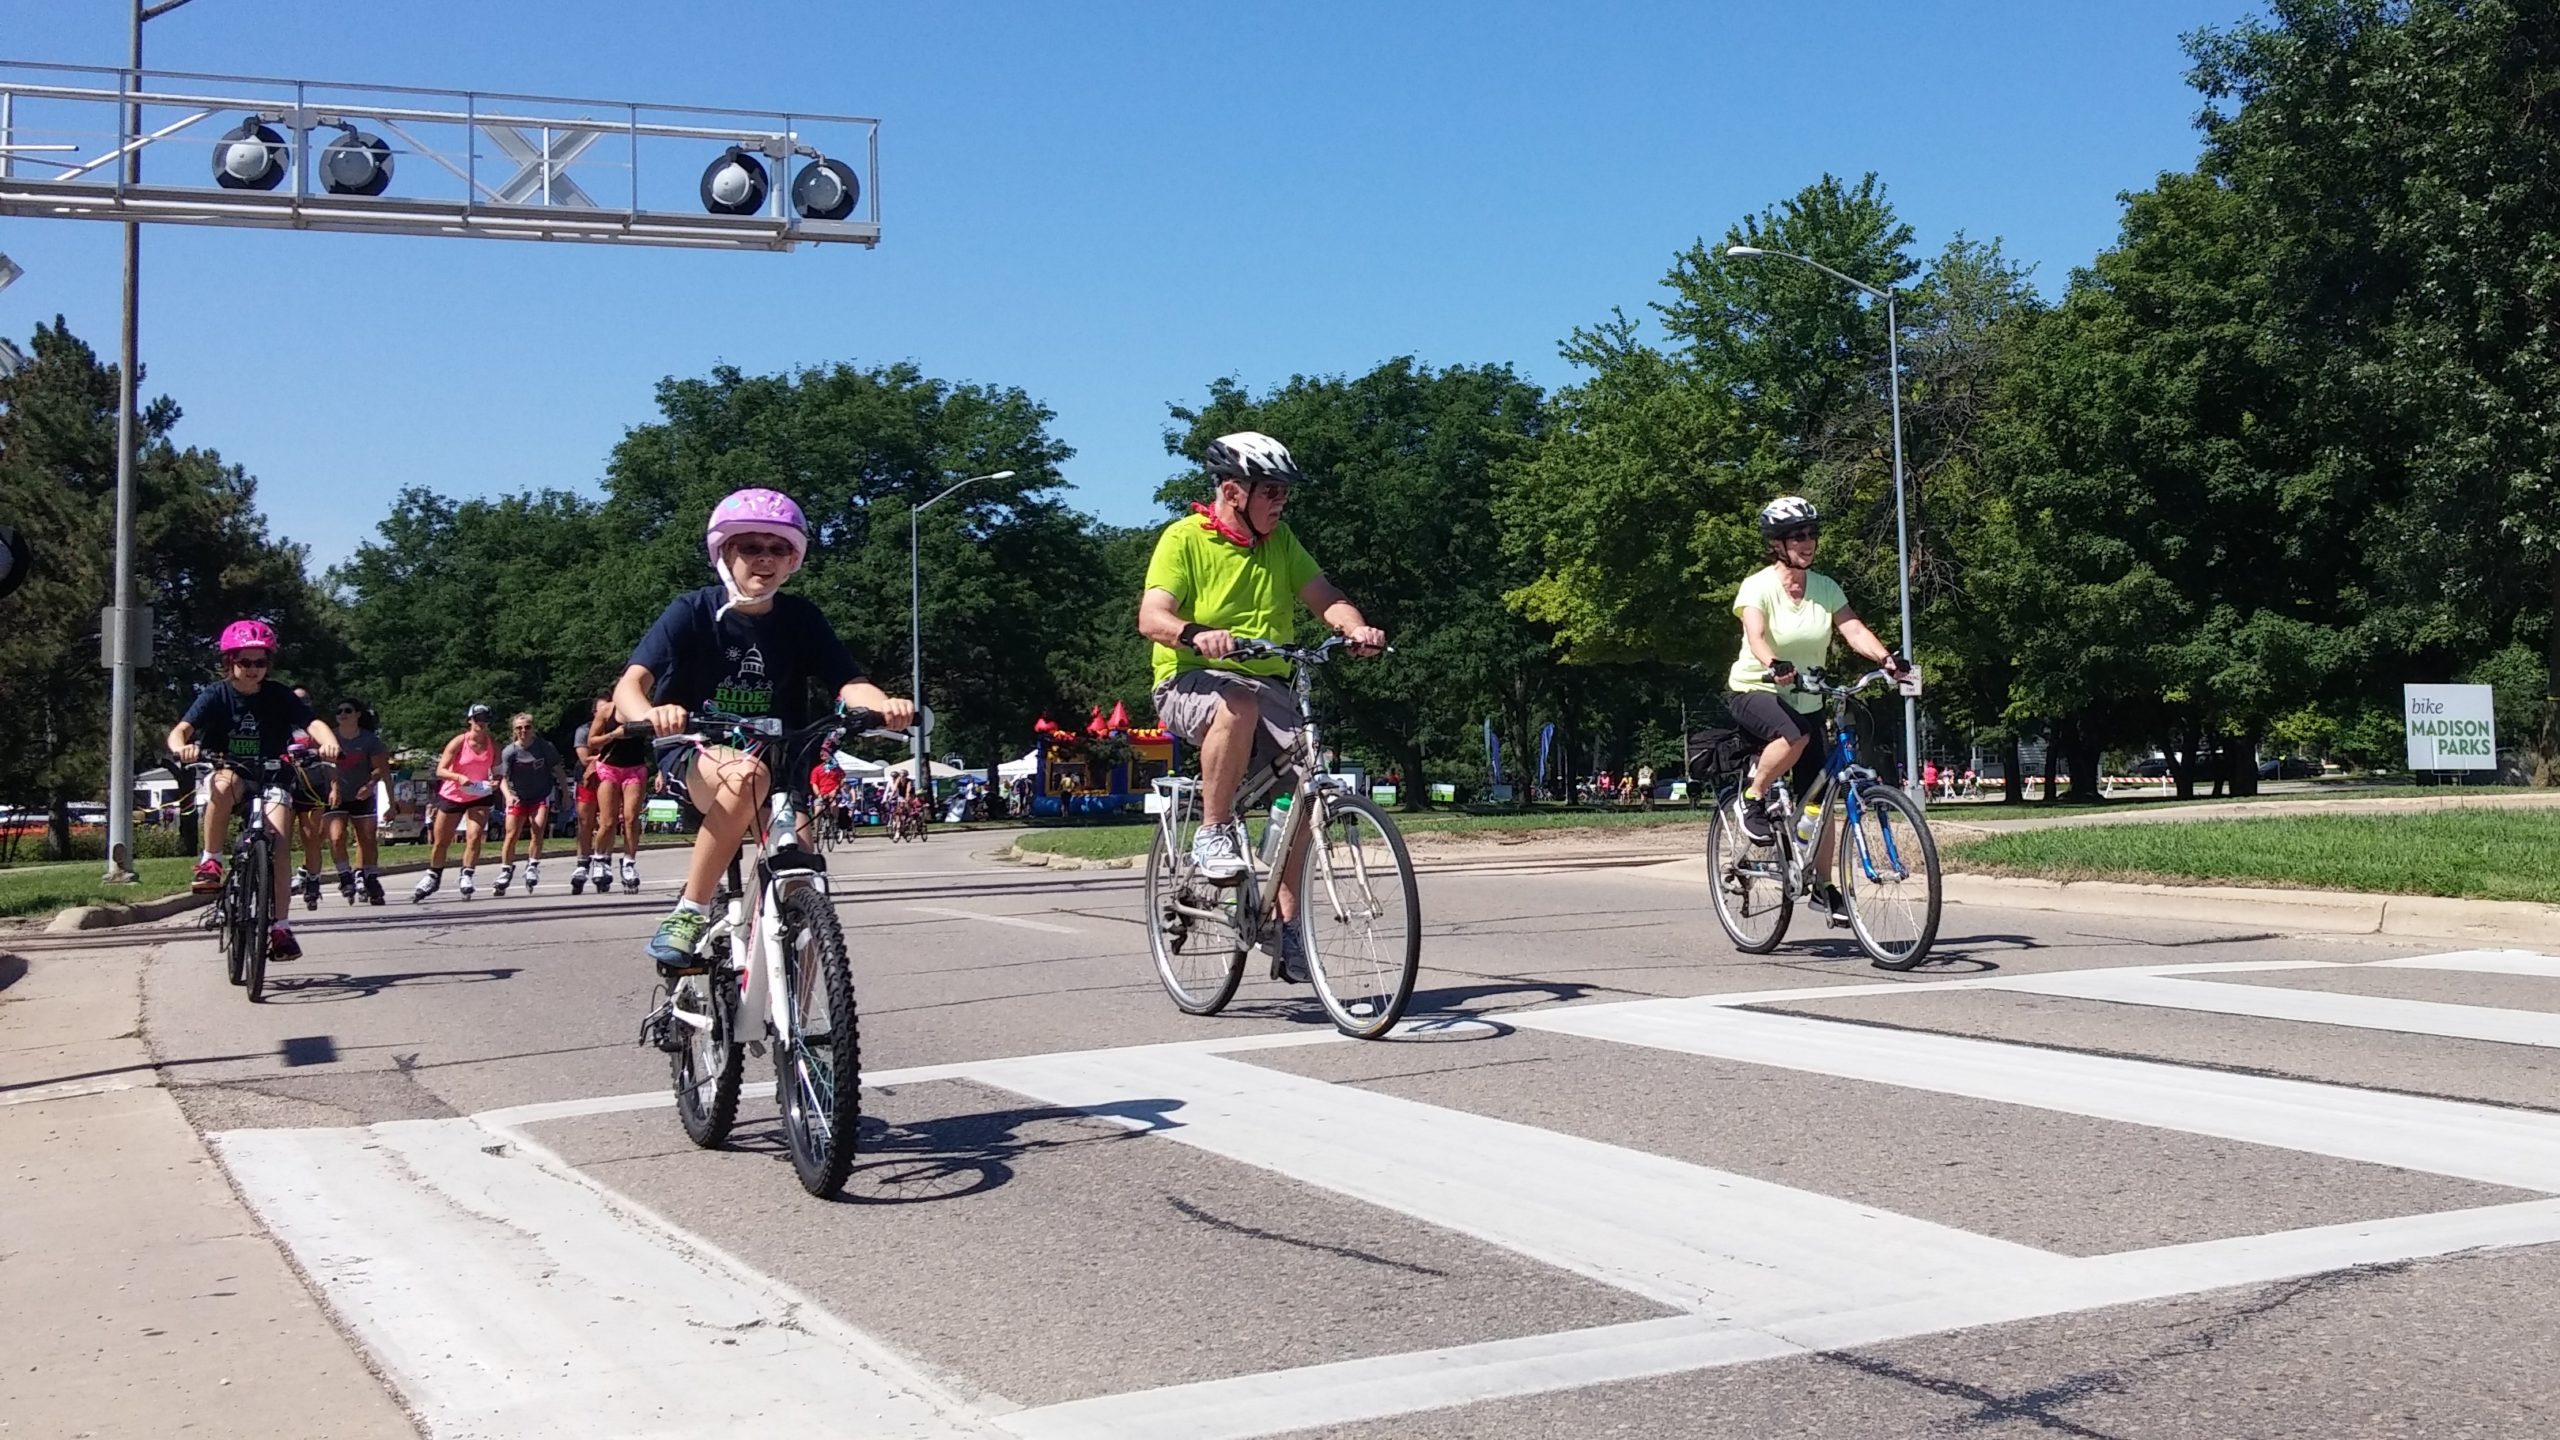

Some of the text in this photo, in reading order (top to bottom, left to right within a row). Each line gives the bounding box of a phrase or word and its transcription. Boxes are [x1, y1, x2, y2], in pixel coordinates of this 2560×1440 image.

[714, 687, 767, 703] RIDE
[2411, 698, 2444, 714] bike
[2411, 720, 2490, 737] MADISON
[2438, 739, 2491, 755] PARKS
